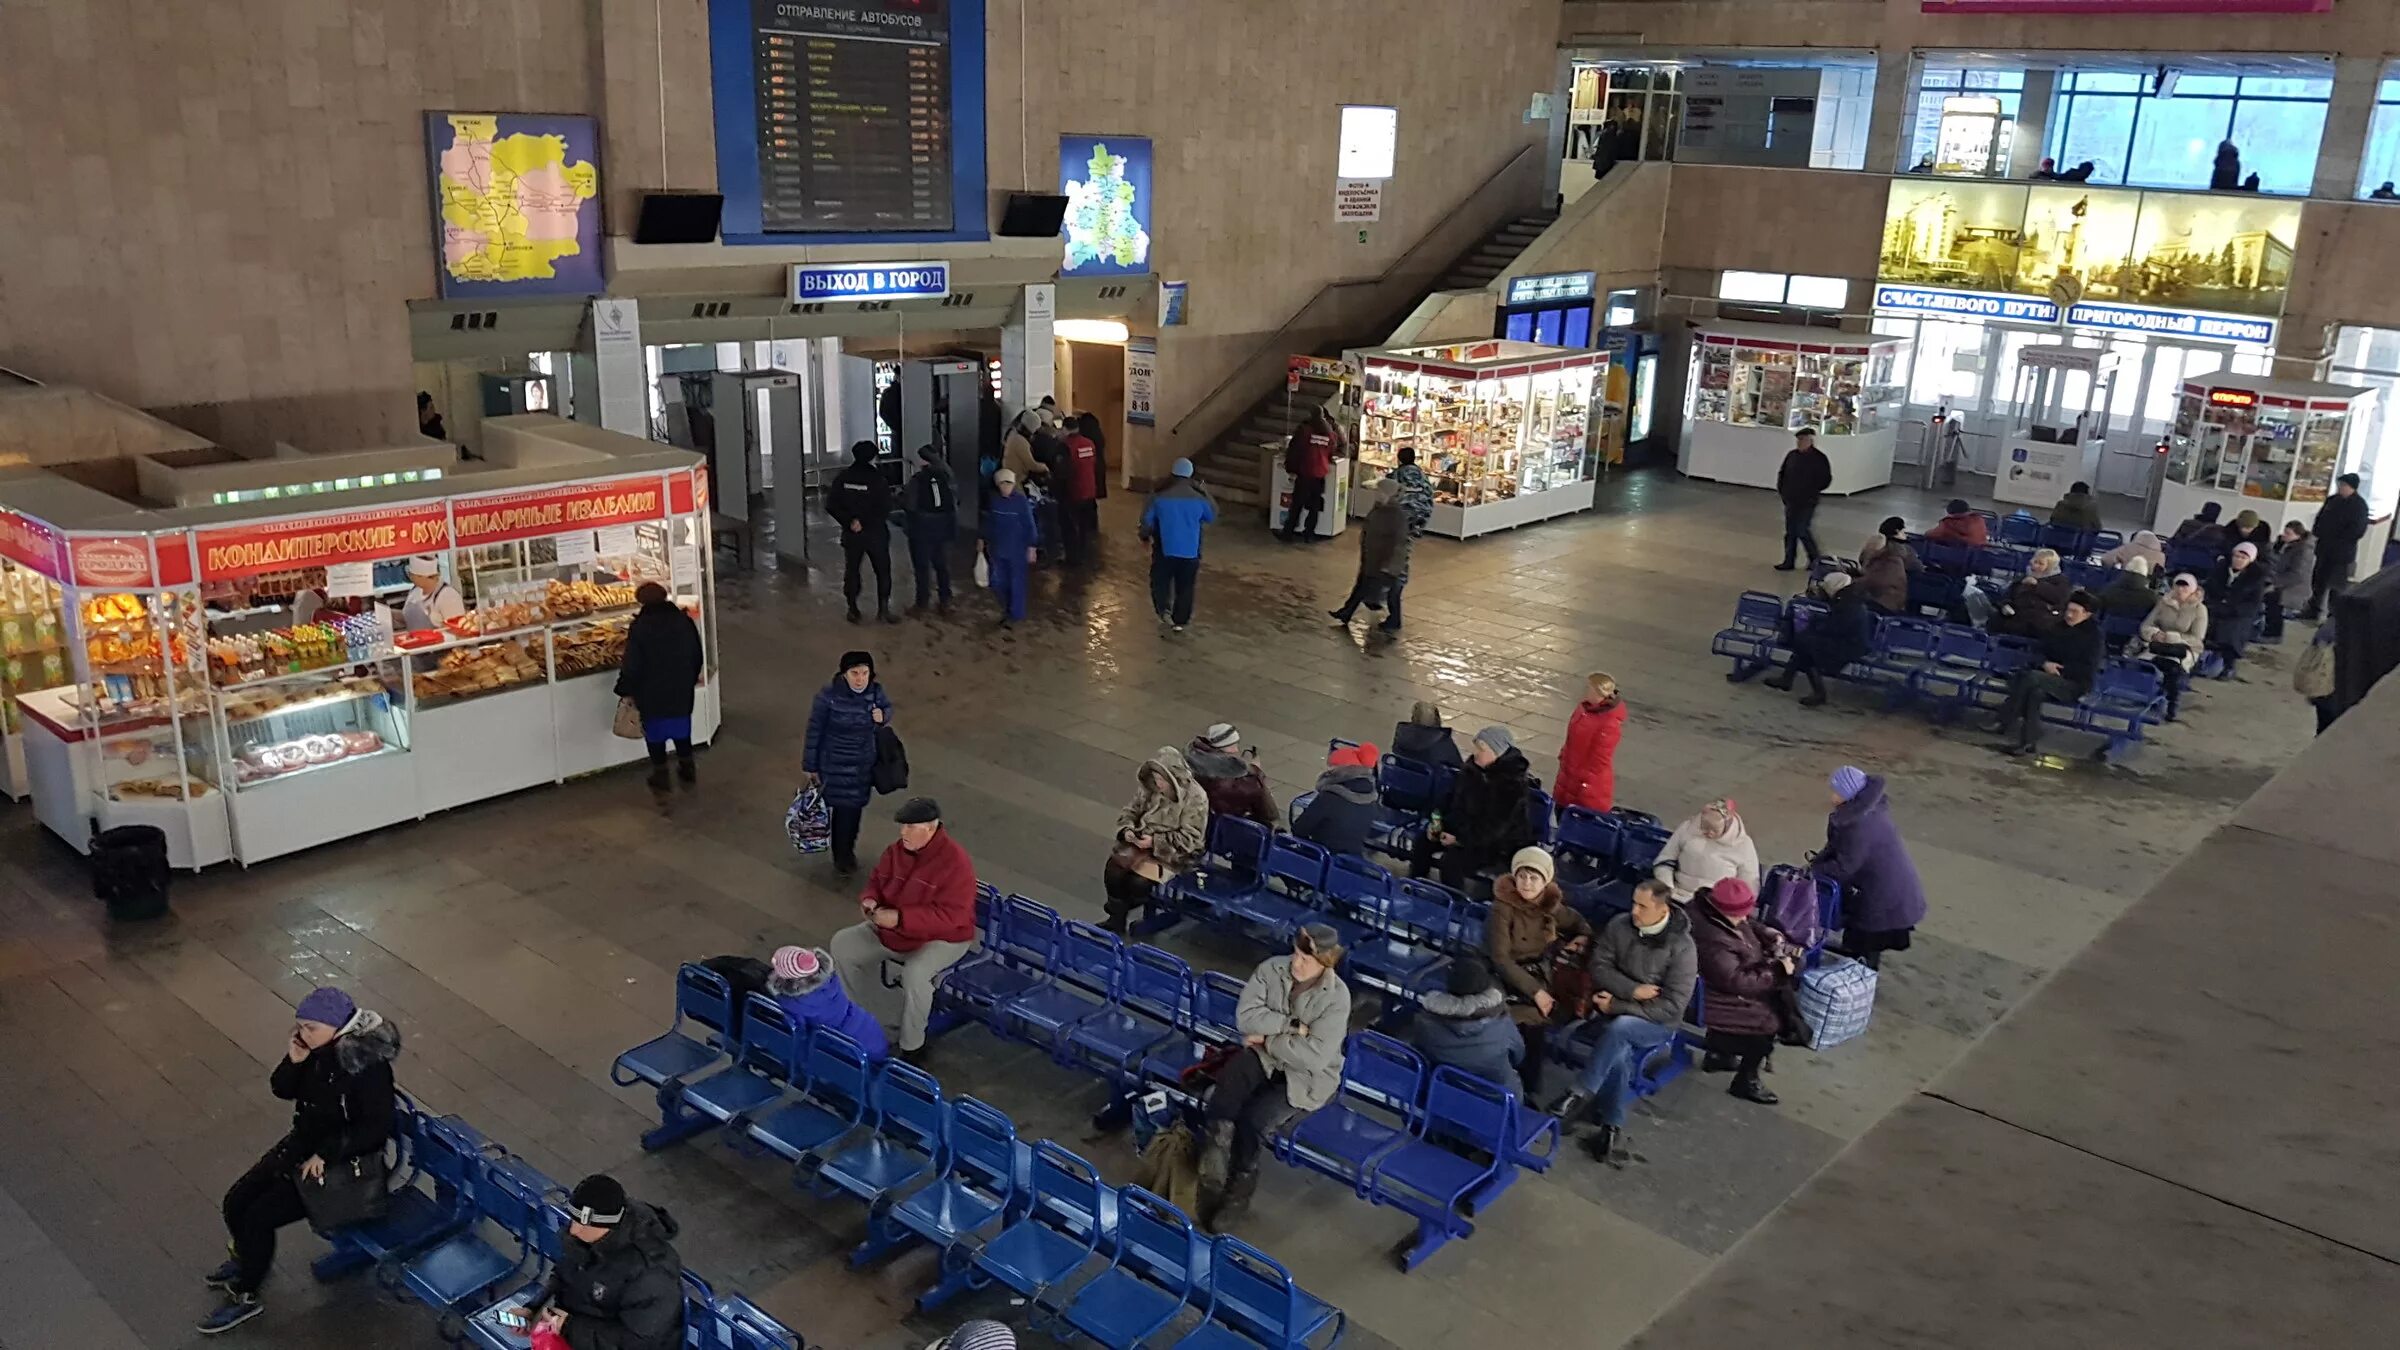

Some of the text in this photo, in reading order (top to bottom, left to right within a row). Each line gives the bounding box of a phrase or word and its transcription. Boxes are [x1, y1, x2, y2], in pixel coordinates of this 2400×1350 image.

[777, 4, 856, 22] ОТПРАВЛЕНИЕ
[861, 13, 922, 27] АВТОБУСОВ
[803, 271, 943, 292] ВЫХОД В ГОРОД
[1880, 290, 2056, 318] СЧАСТЛИВОГО ПУТИ!
[2071, 308, 2269, 339] ПРИГОРОДНЫЙ ПЕРРОН
[208, 524, 396, 571] КОНДИТЕРСКИЕ
[412, 503, 562, 545] КУЛИНАРНЫЕ
[566, 491, 657, 521] ИЗДЕЛИЯ
